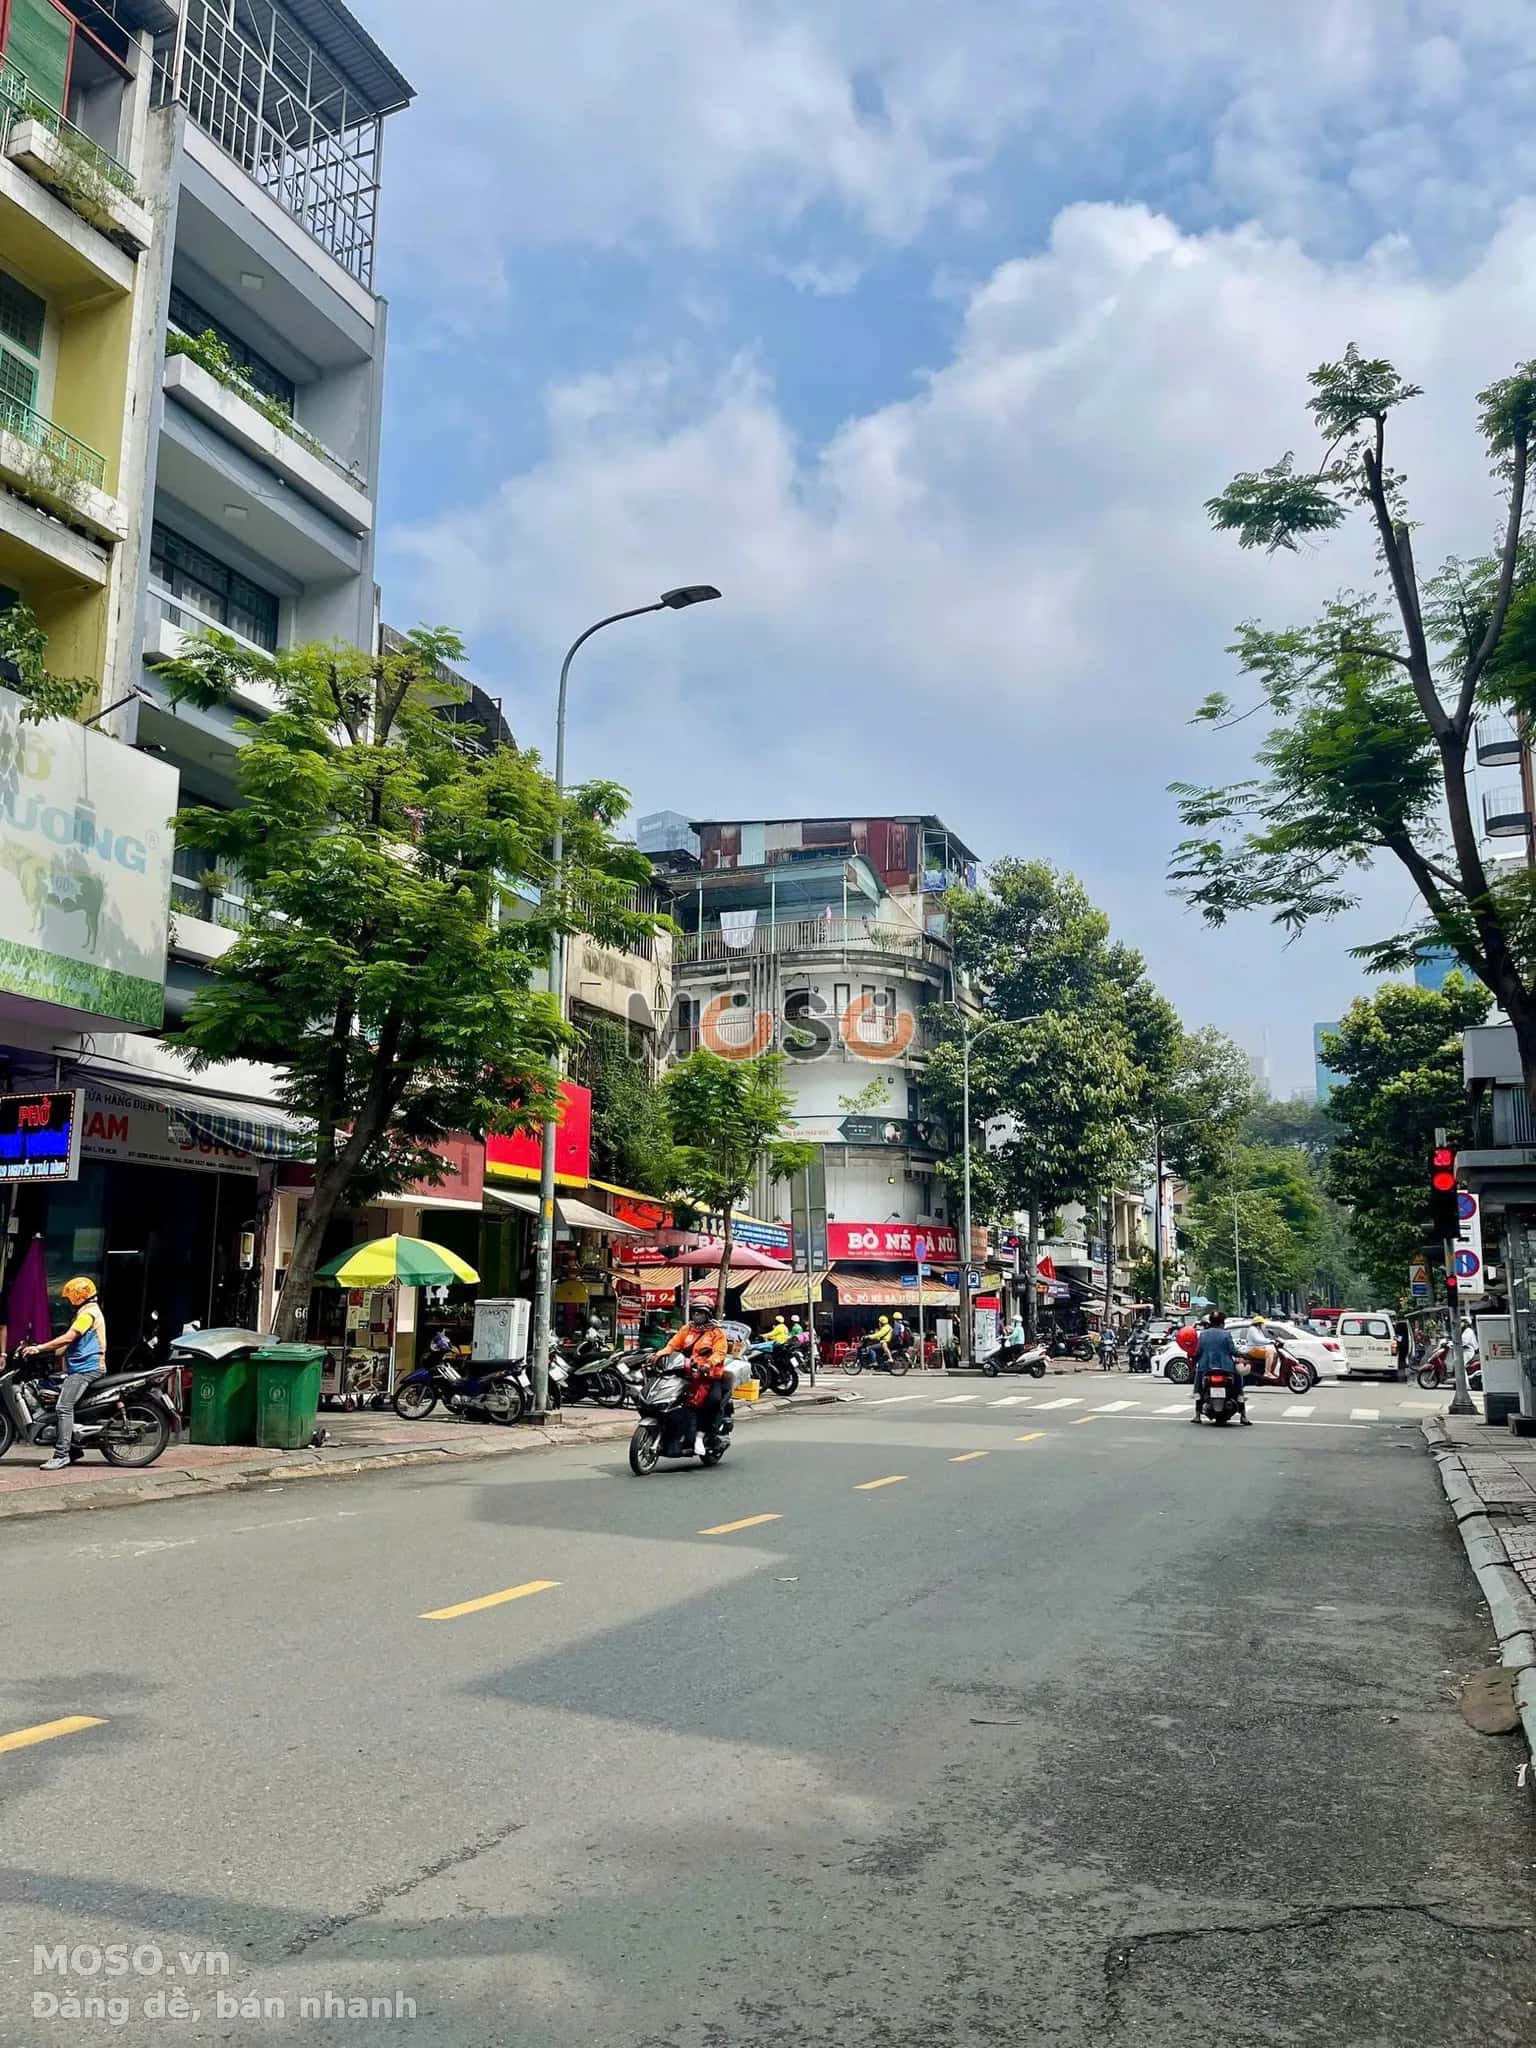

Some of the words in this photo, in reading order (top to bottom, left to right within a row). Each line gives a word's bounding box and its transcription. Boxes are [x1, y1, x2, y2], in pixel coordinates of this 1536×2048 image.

[0, 794, 147, 875] ƯƠNG
[18, 1096, 52, 1127] PHỞ
[847, 1228, 879, 1250] BÒ
[885, 1229, 911, 1251] NÉ
